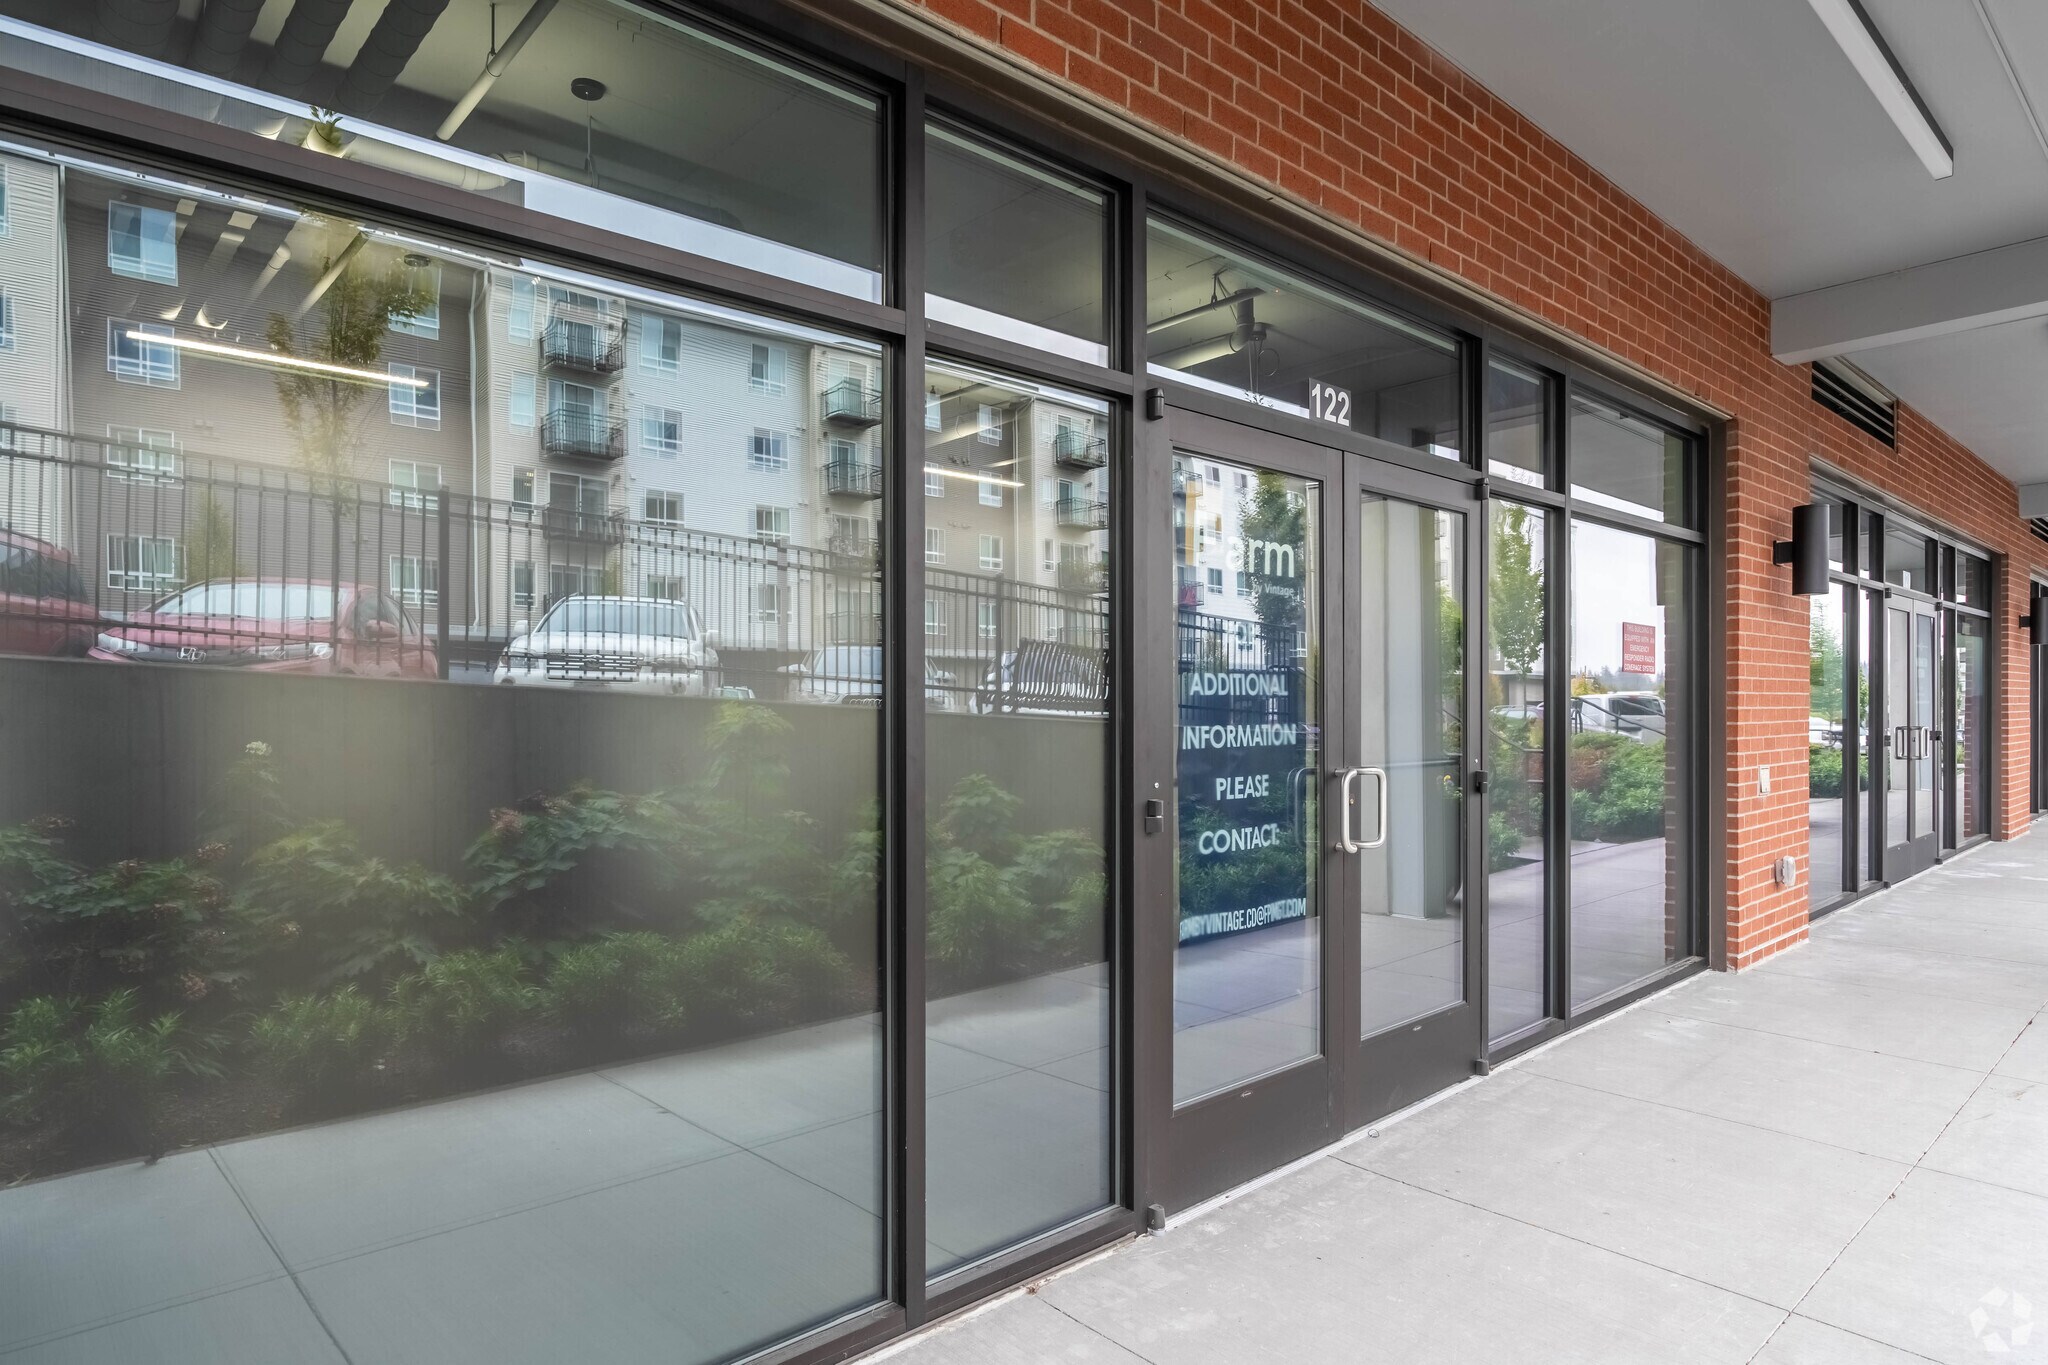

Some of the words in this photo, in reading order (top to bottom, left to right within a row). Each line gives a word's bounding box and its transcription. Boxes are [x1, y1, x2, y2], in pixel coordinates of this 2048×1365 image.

[1311, 383, 1350, 427] 122
[1264, 582, 1295, 599] Vintage
[1189, 672, 1289, 696] ADDITIONAL
[1182, 723, 1297, 749] INFORMATION
[1215, 774, 1270, 801] PLEASE
